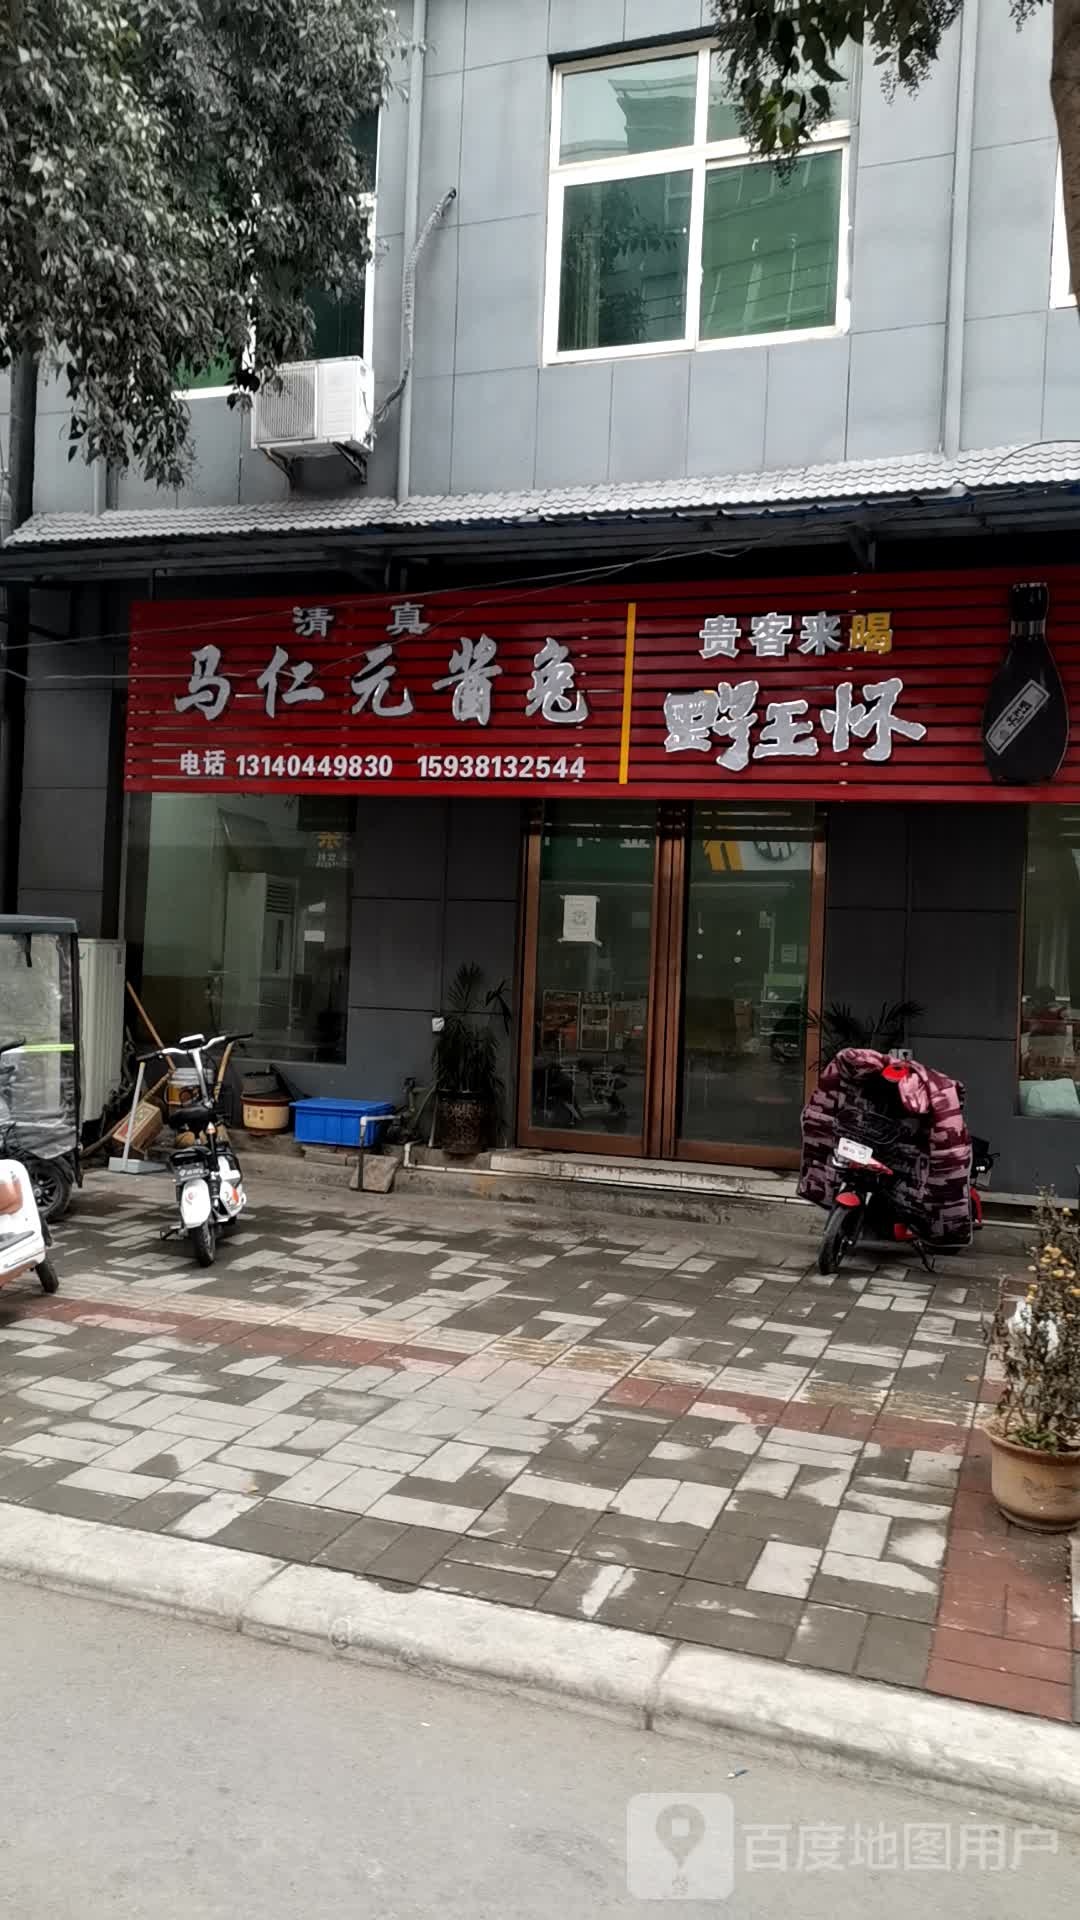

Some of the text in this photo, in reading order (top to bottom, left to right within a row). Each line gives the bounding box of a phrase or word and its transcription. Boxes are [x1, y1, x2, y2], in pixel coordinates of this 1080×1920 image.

[293, 603, 430, 638] 清真
[699, 611, 893, 659] 贵客来喝
[174, 634, 590, 726] 马仁元酱兔
[179, 750, 586, 779] 电话 13140449830 15938132544
